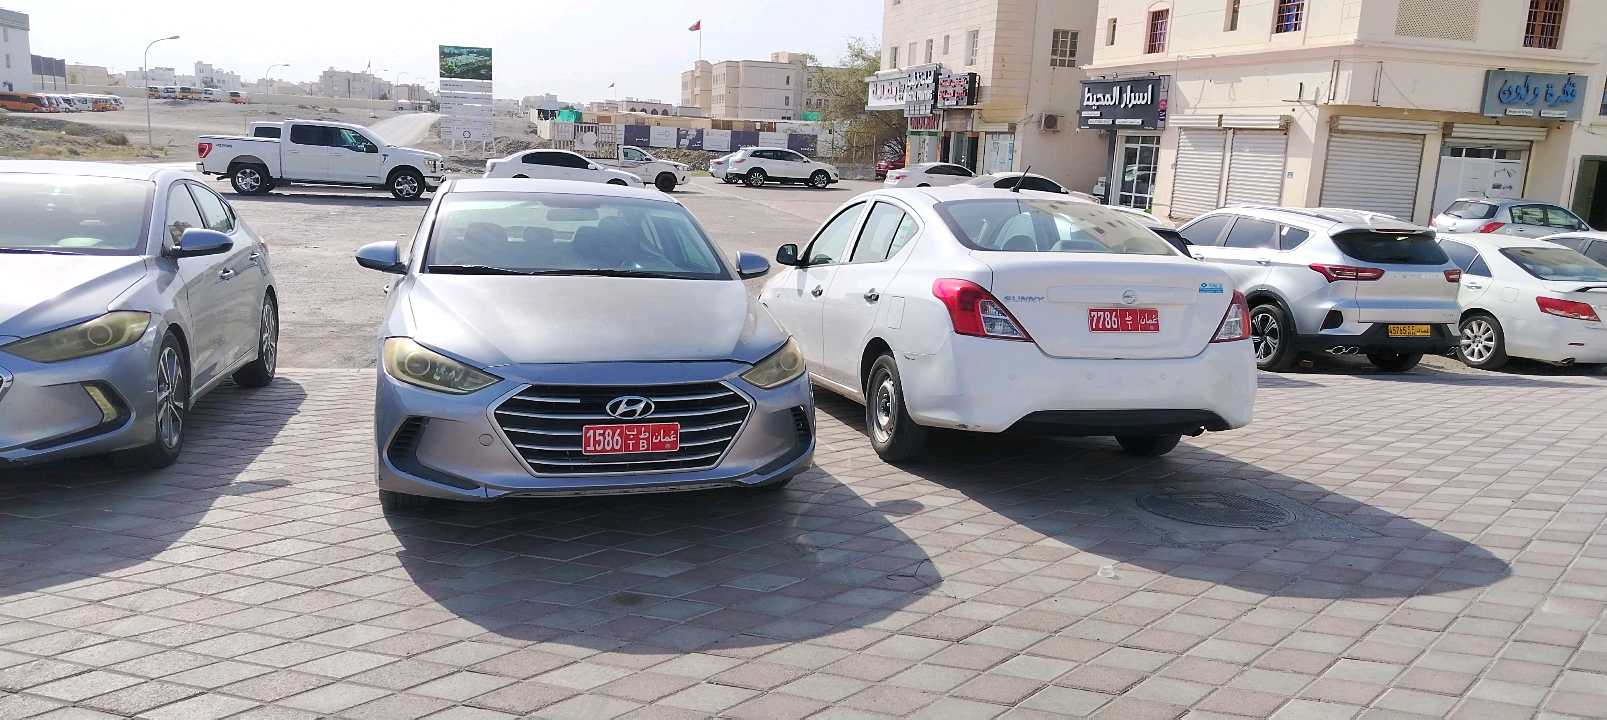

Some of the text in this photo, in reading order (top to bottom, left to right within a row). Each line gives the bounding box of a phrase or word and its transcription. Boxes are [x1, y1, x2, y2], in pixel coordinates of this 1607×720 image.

[1083, 84, 1152, 109] اسرار المحيط
[1091, 311, 1118, 329] 7786
[586, 429, 622, 451] 1586
